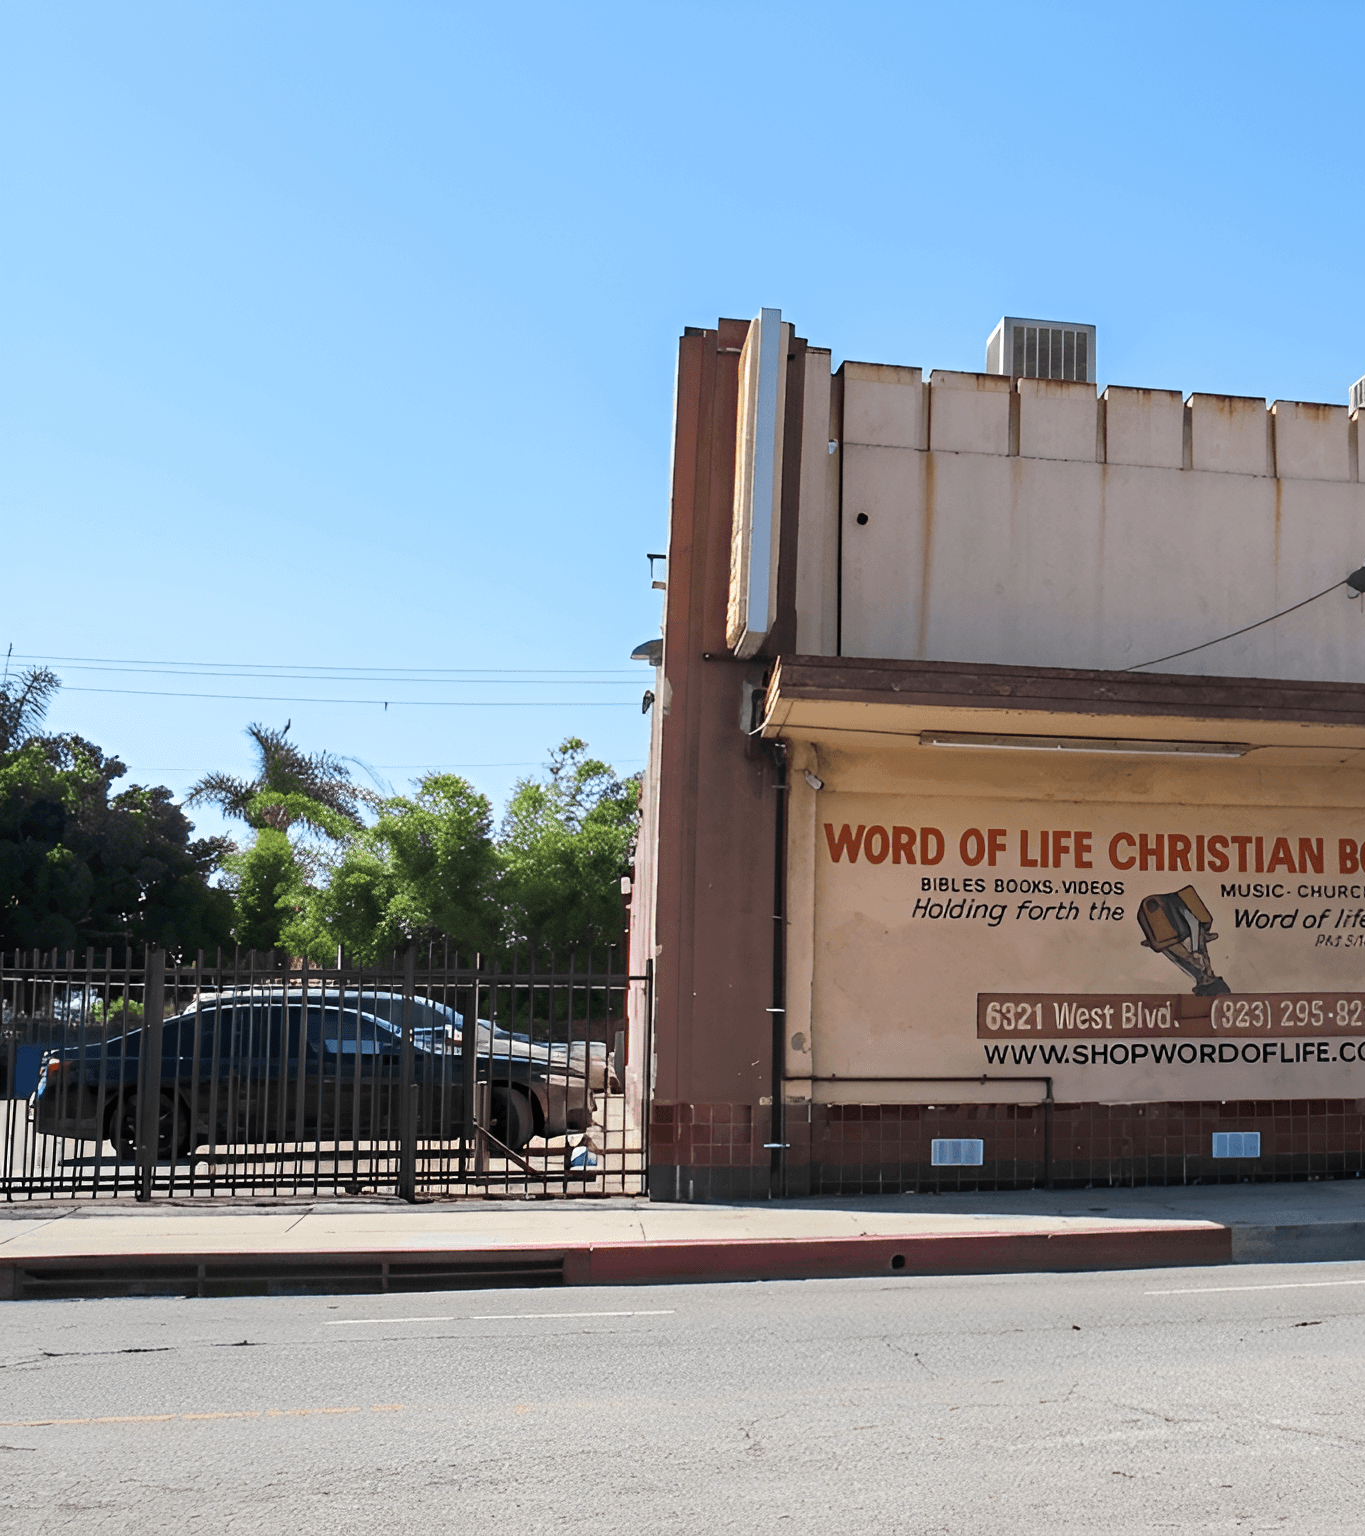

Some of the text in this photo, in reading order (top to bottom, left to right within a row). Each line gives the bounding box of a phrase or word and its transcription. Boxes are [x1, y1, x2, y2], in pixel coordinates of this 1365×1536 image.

[824, 823, 946, 866] WORD
[959, 827, 1007, 867] OF
[1020, 829, 1093, 869] LIFE
[1108, 832, 1324, 875] CHRISTIAN
[920, 877, 986, 893] BIBLES
[912, 897, 1125, 927] Holding forth the
[1234, 908, 1299, 929] Word
[1302, 908, 1332, 929] of
[985, 1001, 1043, 1031] 6321
[1053, 1001, 1114, 1030] West
